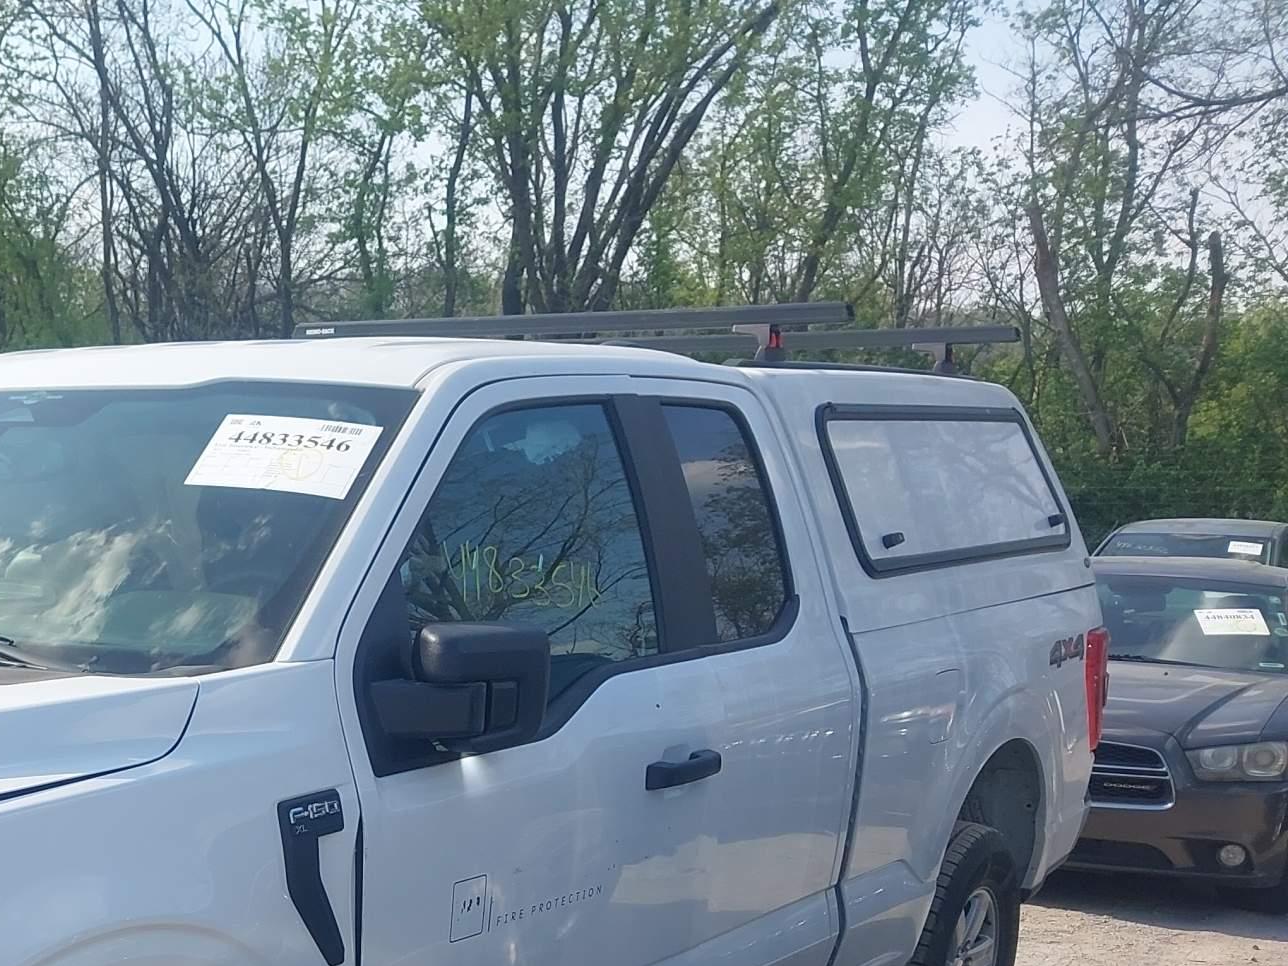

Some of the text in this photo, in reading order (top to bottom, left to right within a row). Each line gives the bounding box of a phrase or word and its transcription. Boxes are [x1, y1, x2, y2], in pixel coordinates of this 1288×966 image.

[228, 430, 353, 453] 44833546
[441, 539, 601, 609] 44833546
[289, 800, 341, 824] F-150
[295, 824, 310, 835] XL
[495, 884, 604, 927] FIRE PROTECTION
